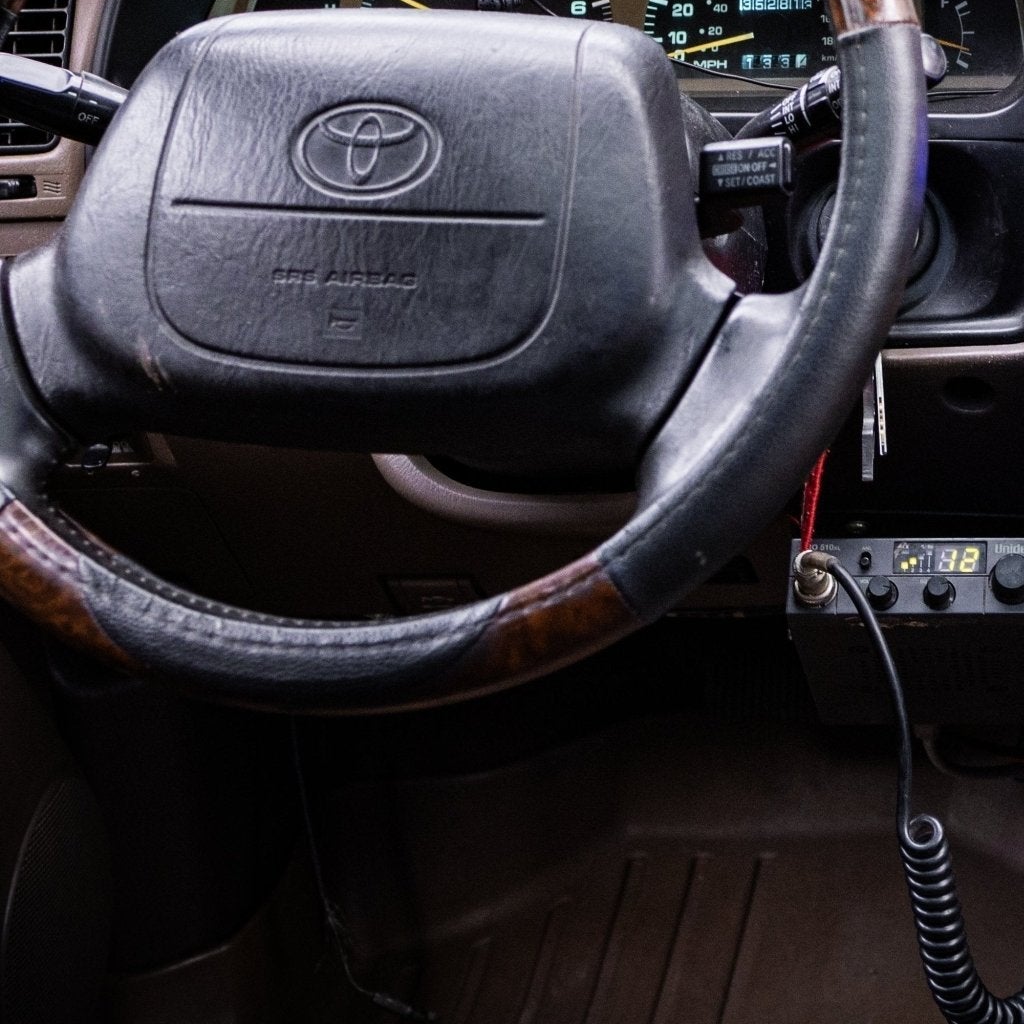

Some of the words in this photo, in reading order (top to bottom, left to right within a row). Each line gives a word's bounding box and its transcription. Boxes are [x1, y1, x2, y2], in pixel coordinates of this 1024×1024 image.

[570, 0, 586, 15] 6
[671, 3, 694, 17] 20
[713, 3, 728, 13] 40
[708, 26, 723, 36] 20
[667, 31, 687, 45] 10
[693, 59, 728, 69] MPH
[77, 112, 100, 125] OFF
[784, 112, 795, 125] LO
[757, 148, 776, 158] ACC
